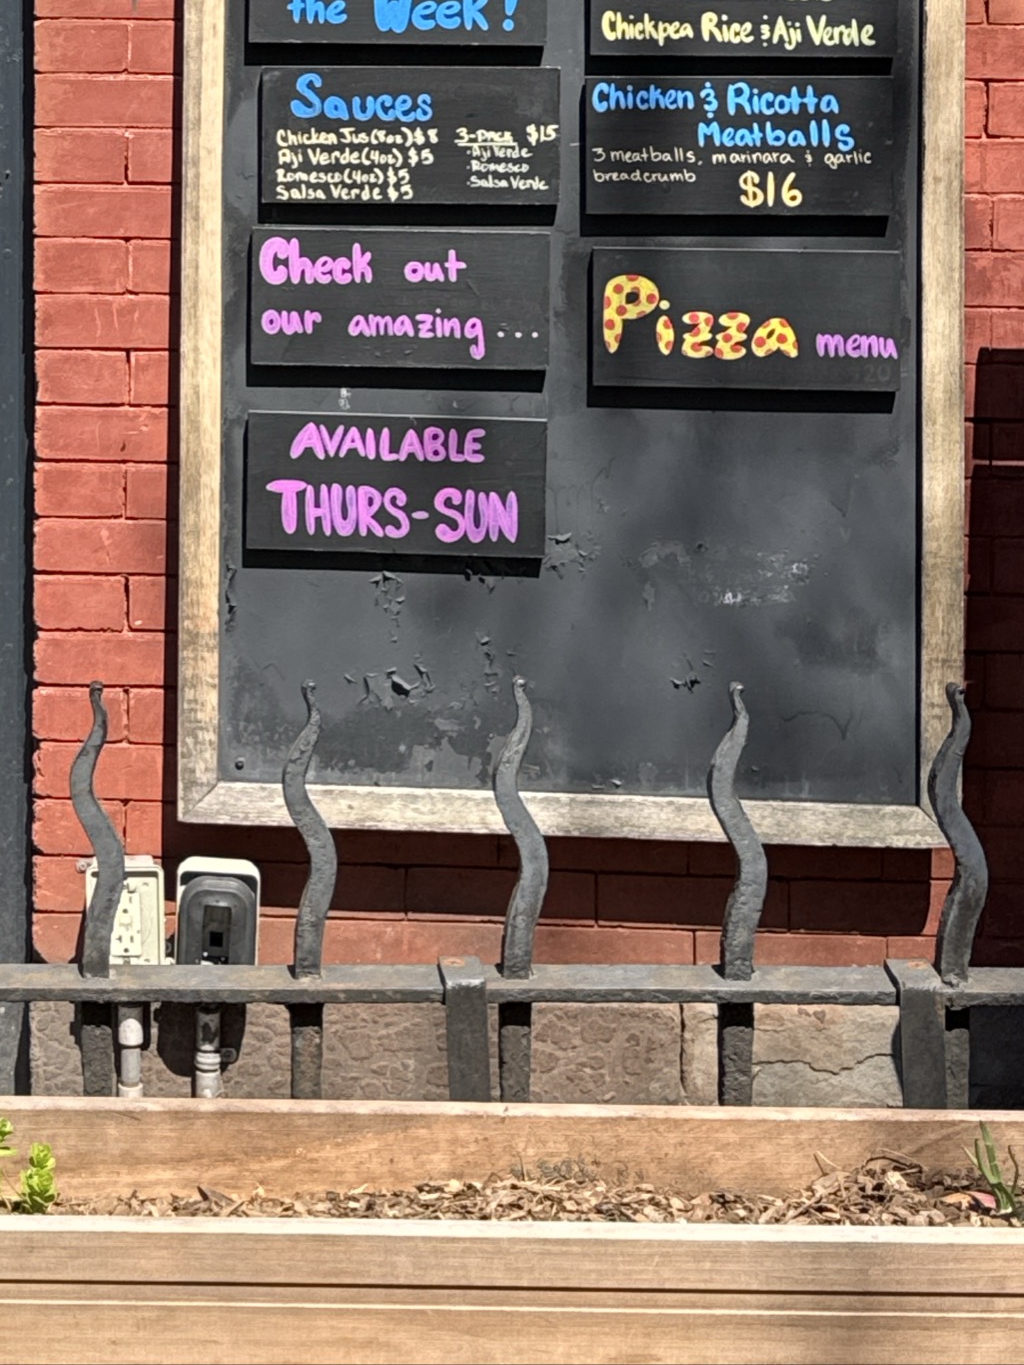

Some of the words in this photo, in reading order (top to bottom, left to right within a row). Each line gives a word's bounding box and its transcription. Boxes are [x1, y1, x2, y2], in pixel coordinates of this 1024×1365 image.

[601, 10, 694, 47] Chickpea
[700, 11, 754, 44] Rice
[772, 15, 802, 50] Aji
[806, 14, 876, 47] Verde
[290, 73, 433, 122] Sauces
[591, 83, 695, 113] Chicken
[727, 82, 839, 116] Ricotta
[277, 127, 337, 147] Chicken
[339, 127, 369, 143] Jus
[526, 124, 559, 146] $15
[698, 119, 855, 151] Meatballs
[278, 148, 303, 169] Aji
[408, 147, 434, 167] $5
[591, 148, 606, 162] 3
[712, 152, 795, 164] marinara
[824, 150, 872, 169] garlic
[276, 184, 326, 200] Salsa
[330, 184, 383, 200] Verde
[739, 170, 803, 208] $16
[259, 237, 373, 285] Check
[404, 249, 467, 283] out
[261, 309, 322, 335] our
[348, 308, 486, 360] amazing
[816, 332, 898, 360] menu
[289, 421, 486, 463] AVAILABLE
